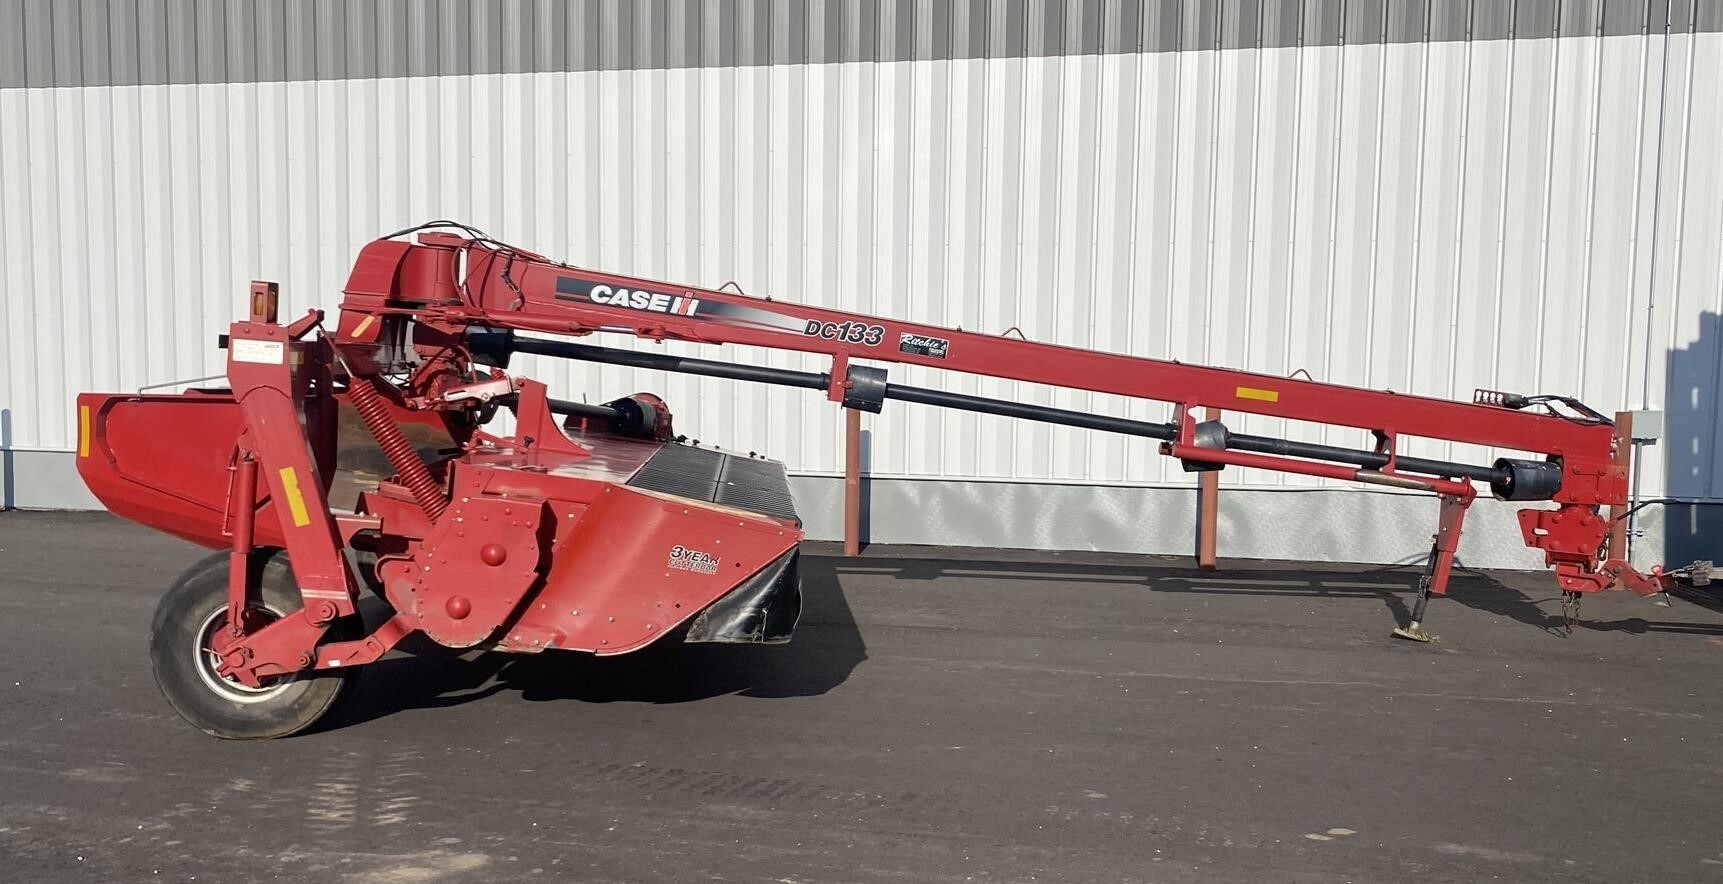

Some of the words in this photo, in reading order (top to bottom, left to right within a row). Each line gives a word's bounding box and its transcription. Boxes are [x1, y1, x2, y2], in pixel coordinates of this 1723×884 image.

[590, 284, 671, 313] CASE
[804, 319, 885, 346] DC133
[901, 334, 946, 350] Ritchie's
